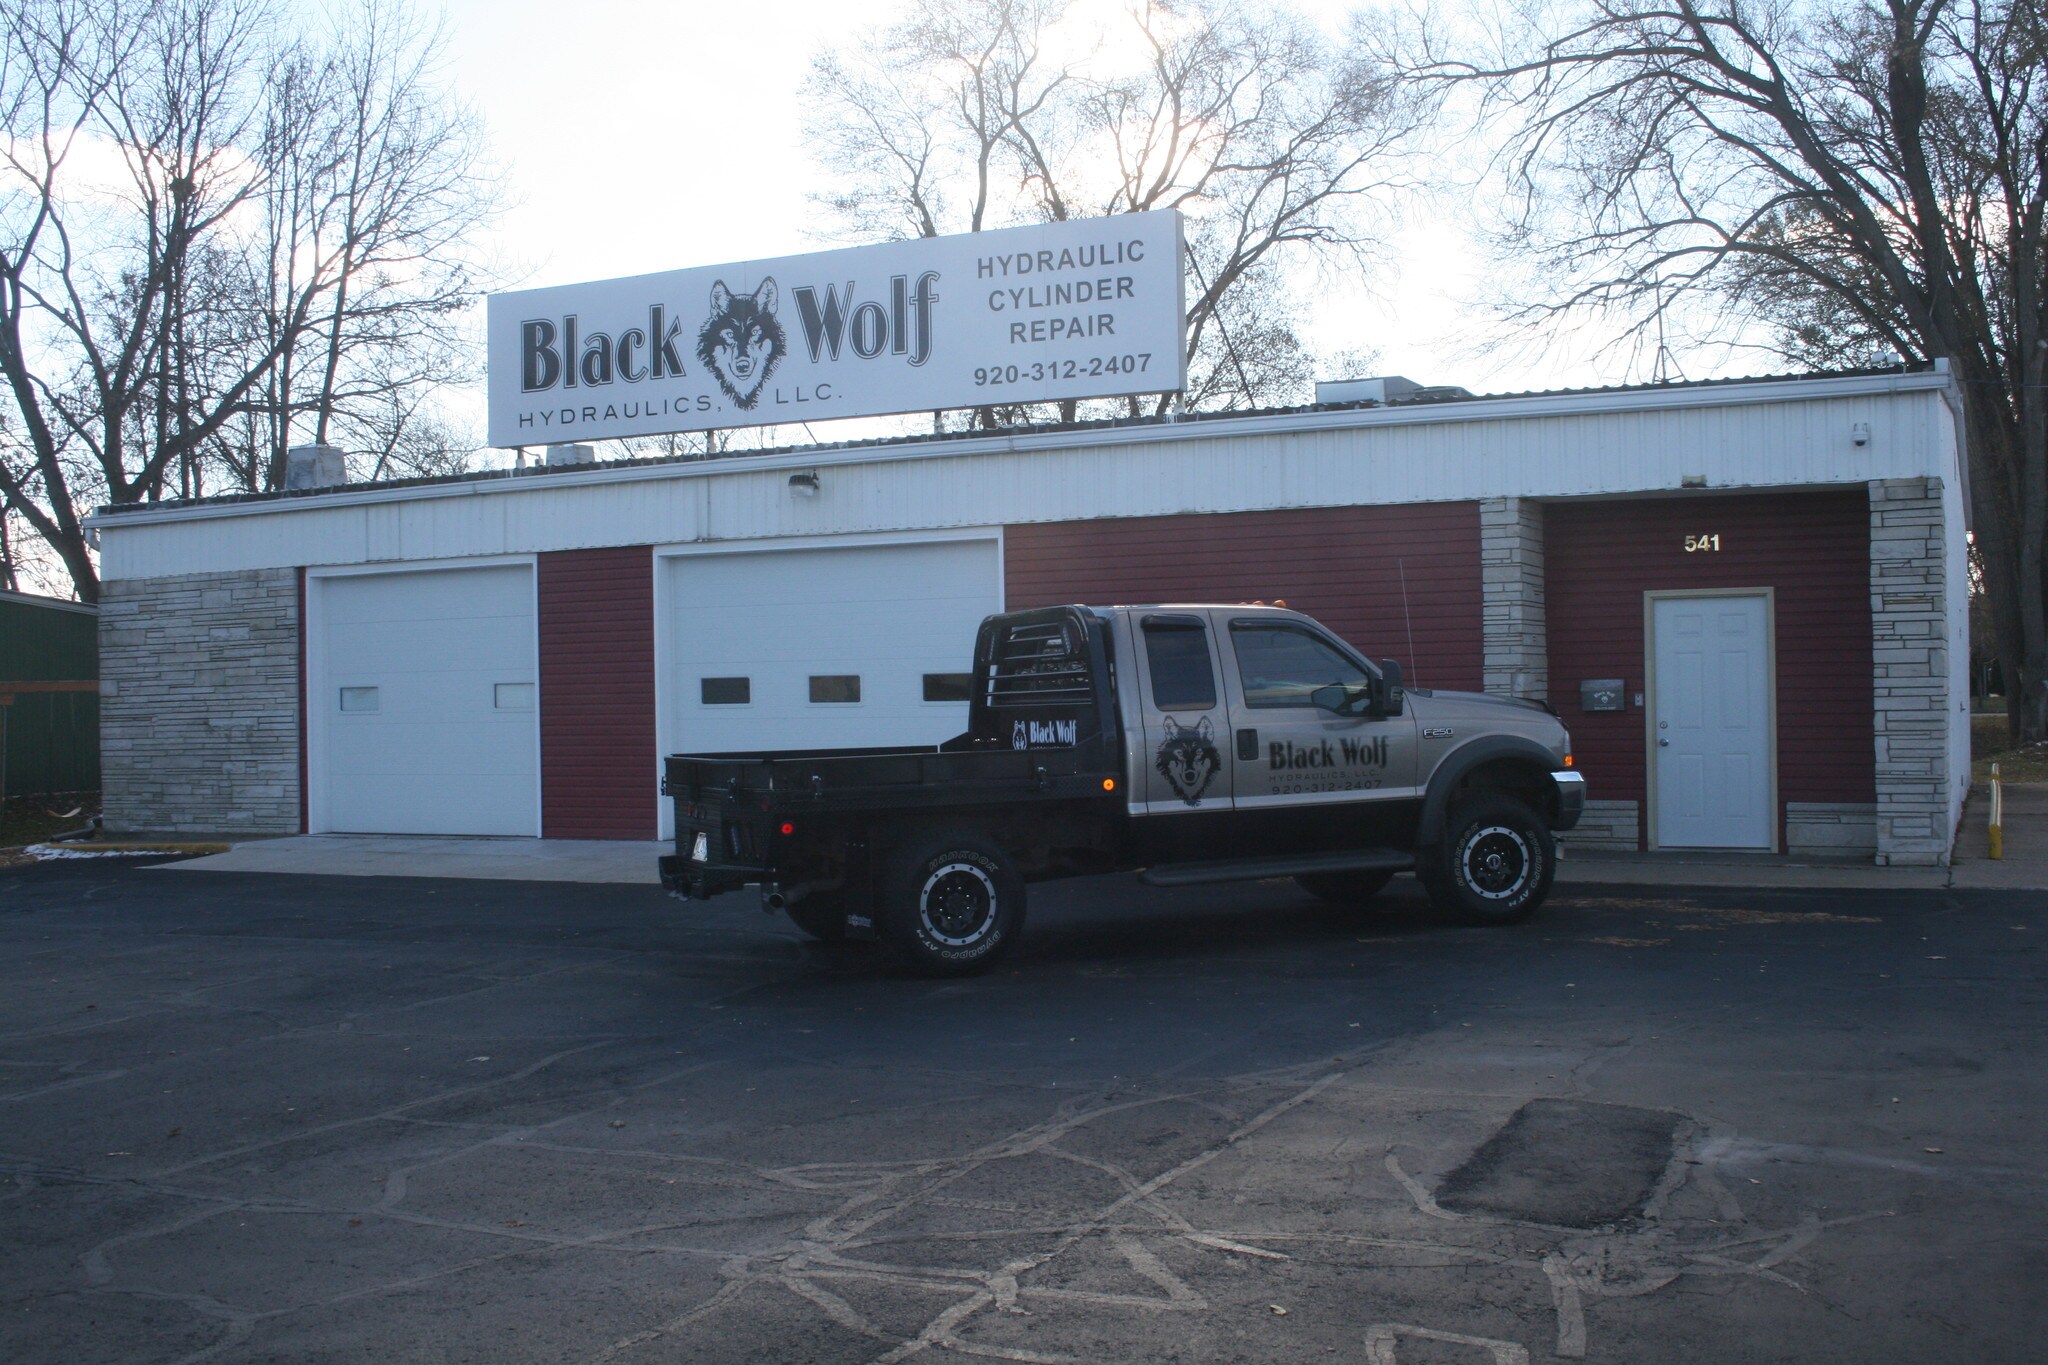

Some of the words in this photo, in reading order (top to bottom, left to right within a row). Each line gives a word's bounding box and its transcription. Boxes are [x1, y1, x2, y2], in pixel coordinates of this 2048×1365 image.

[977, 240, 1145, 279] HYDRAULIC
[988, 276, 1135, 312] CYLINDER
[520, 303, 687, 394] Black
[791, 270, 942, 368] Wolf
[1010, 313, 1116, 344] REPAIR
[974, 353, 1152, 387] 920-312-2407
[519, 395, 721, 428] HYDRAULICS,
[775, 383, 843, 404] LLC.
[1684, 534, 1720, 552] 541
[1029, 720, 1056, 743] Black
[1056, 720, 1077, 746] Wolf
[1268, 737, 1336, 771] Black
[1337, 734, 1389, 768] Wolf
[1272, 779, 1383, 796] 920-312-2407
